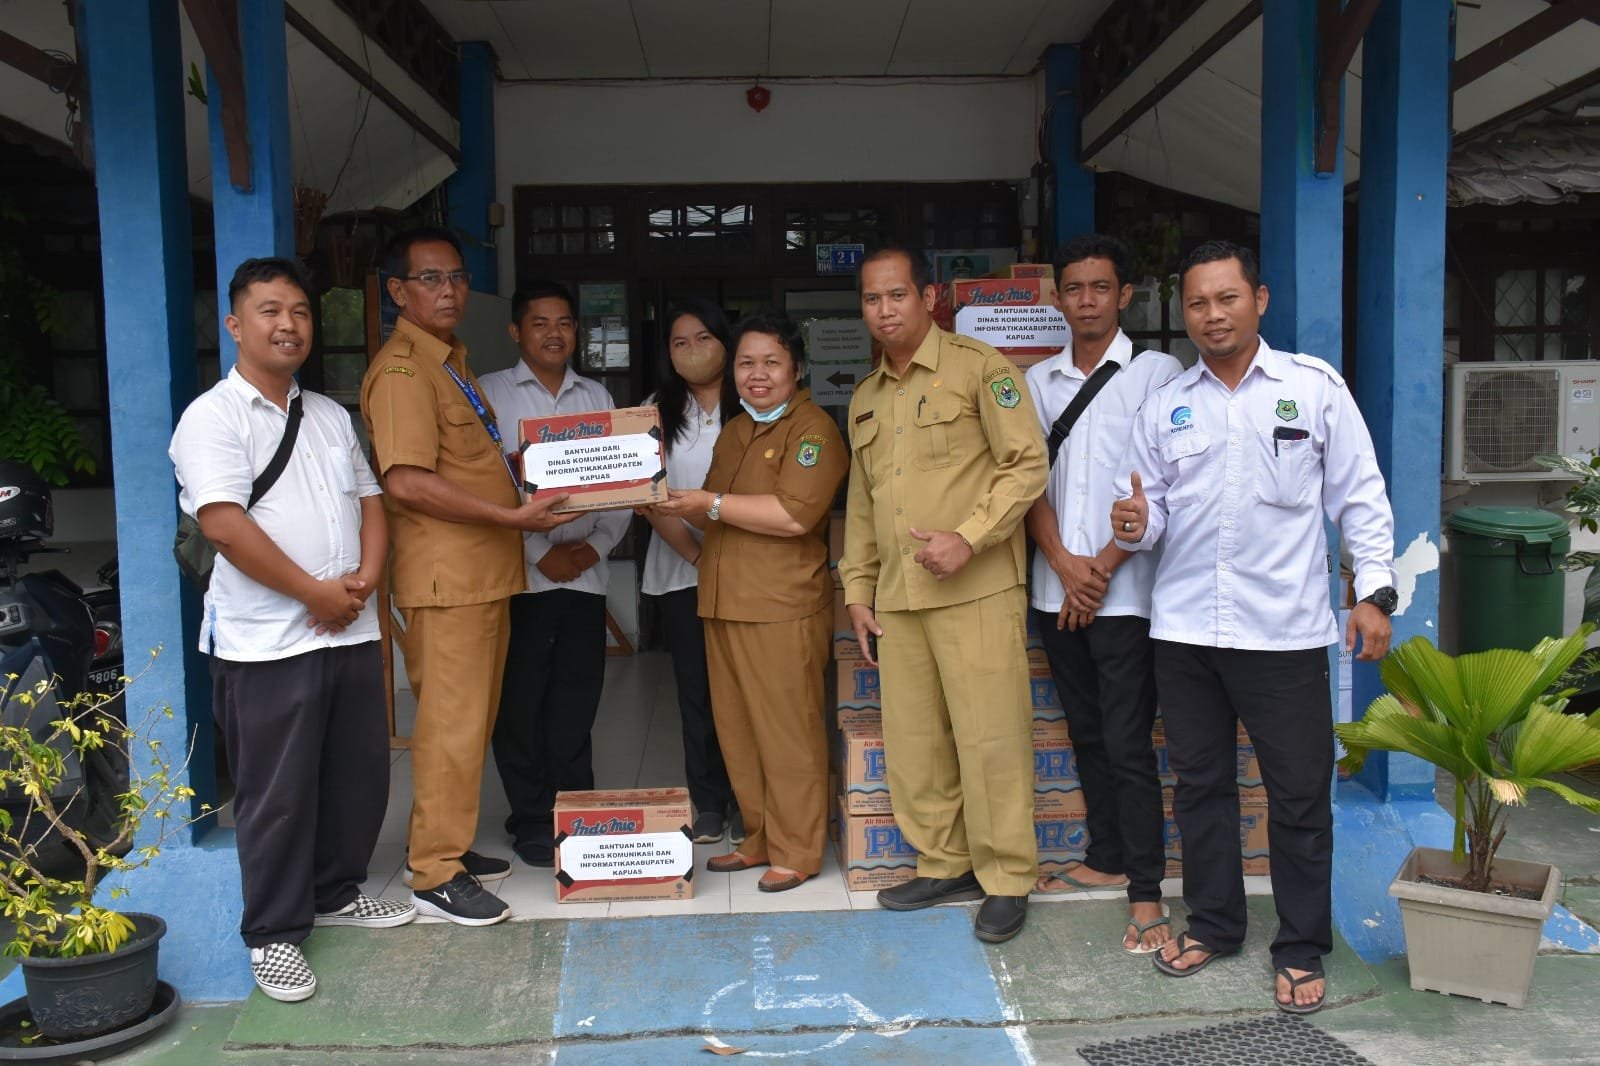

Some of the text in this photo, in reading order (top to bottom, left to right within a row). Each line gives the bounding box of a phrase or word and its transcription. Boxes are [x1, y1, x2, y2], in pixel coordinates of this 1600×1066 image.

[564, 445, 601, 456] BANTUAN
[547, 458, 571, 467] DINAS
[572, 454, 621, 465] KOMUNIKASI
[545, 460, 643, 476] INFORMATIKAKABUPATEN
[579, 473, 611, 482] KAPUAS
[599, 842, 635, 850] BANTUAN
[582, 852, 606, 860] DINAS
[580, 858, 675, 868] INFORMATIKAKABUPATEN
